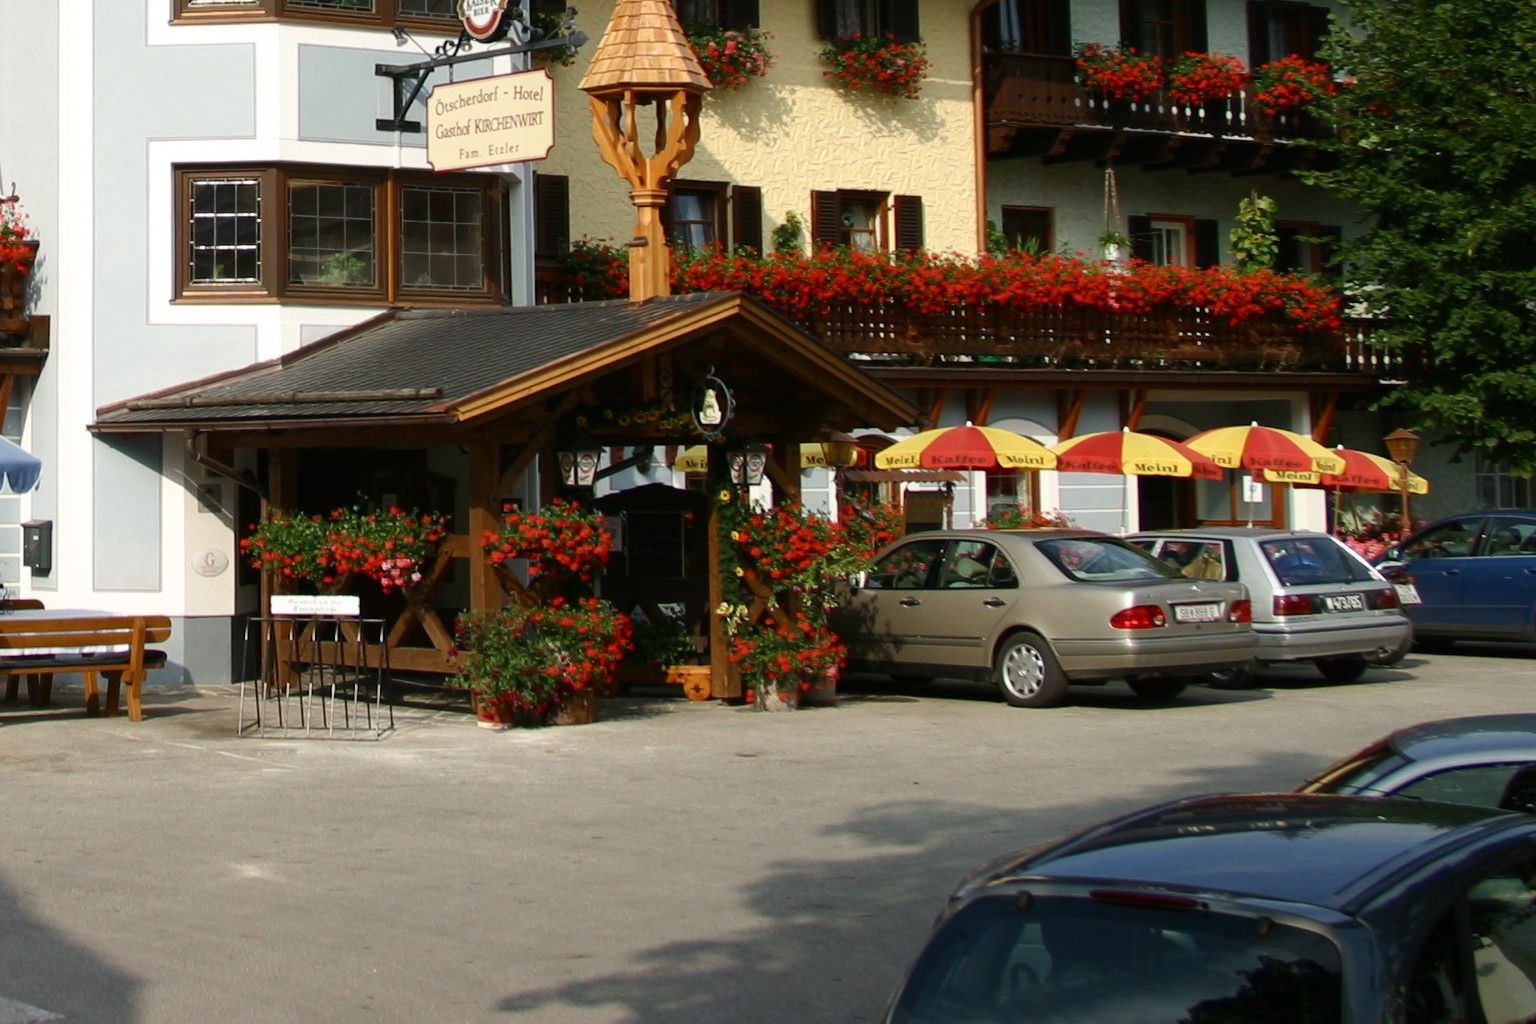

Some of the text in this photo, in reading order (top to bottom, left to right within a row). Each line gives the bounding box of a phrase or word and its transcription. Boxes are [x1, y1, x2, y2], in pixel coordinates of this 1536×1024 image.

[513, 85, 544, 102] Hotel
[435, 110, 544, 140] Gasthof KIRCHENWIRT
[488, 142, 520, 156] Etzler
[885, 455, 915, 465] Meinl
[931, 454, 986, 465] Kaffee
[1005, 455, 1045, 465] Meinl
[1250, 456, 1303, 468] Kaffee
[1134, 463, 1179, 473] Meinl
[1276, 471, 1313, 481] Meinl
